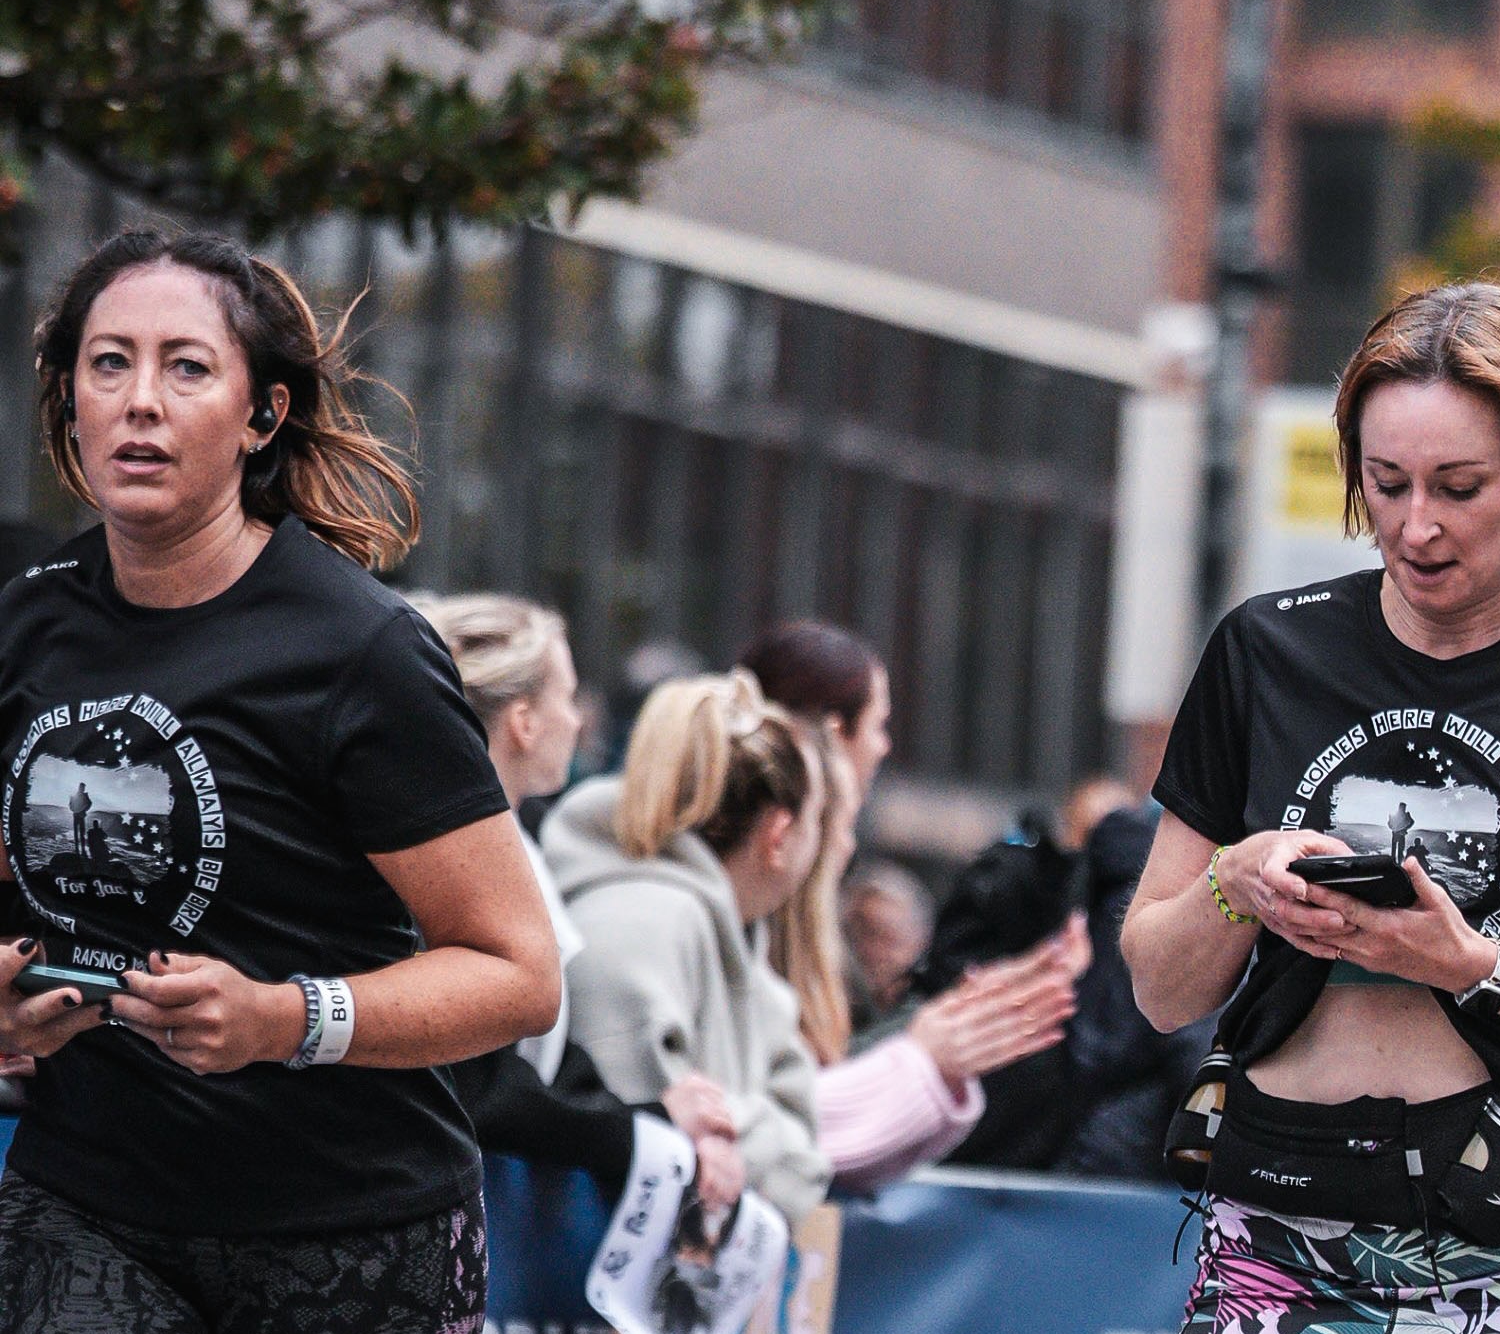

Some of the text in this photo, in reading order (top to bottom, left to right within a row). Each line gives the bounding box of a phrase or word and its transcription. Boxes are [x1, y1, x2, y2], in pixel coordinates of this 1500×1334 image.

[1295, 591, 1332, 606] JAKO
[130, 693, 182, 740] WILL
[1296, 724, 1368, 800] COMES
[1371, 709, 1435, 737] HERE
[174, 737, 226, 848] ALWAYS
[195, 856, 222, 892] BE
[72, 946, 126, 971] RAISING
[1259, 1169, 1308, 1187] FITLETIC
